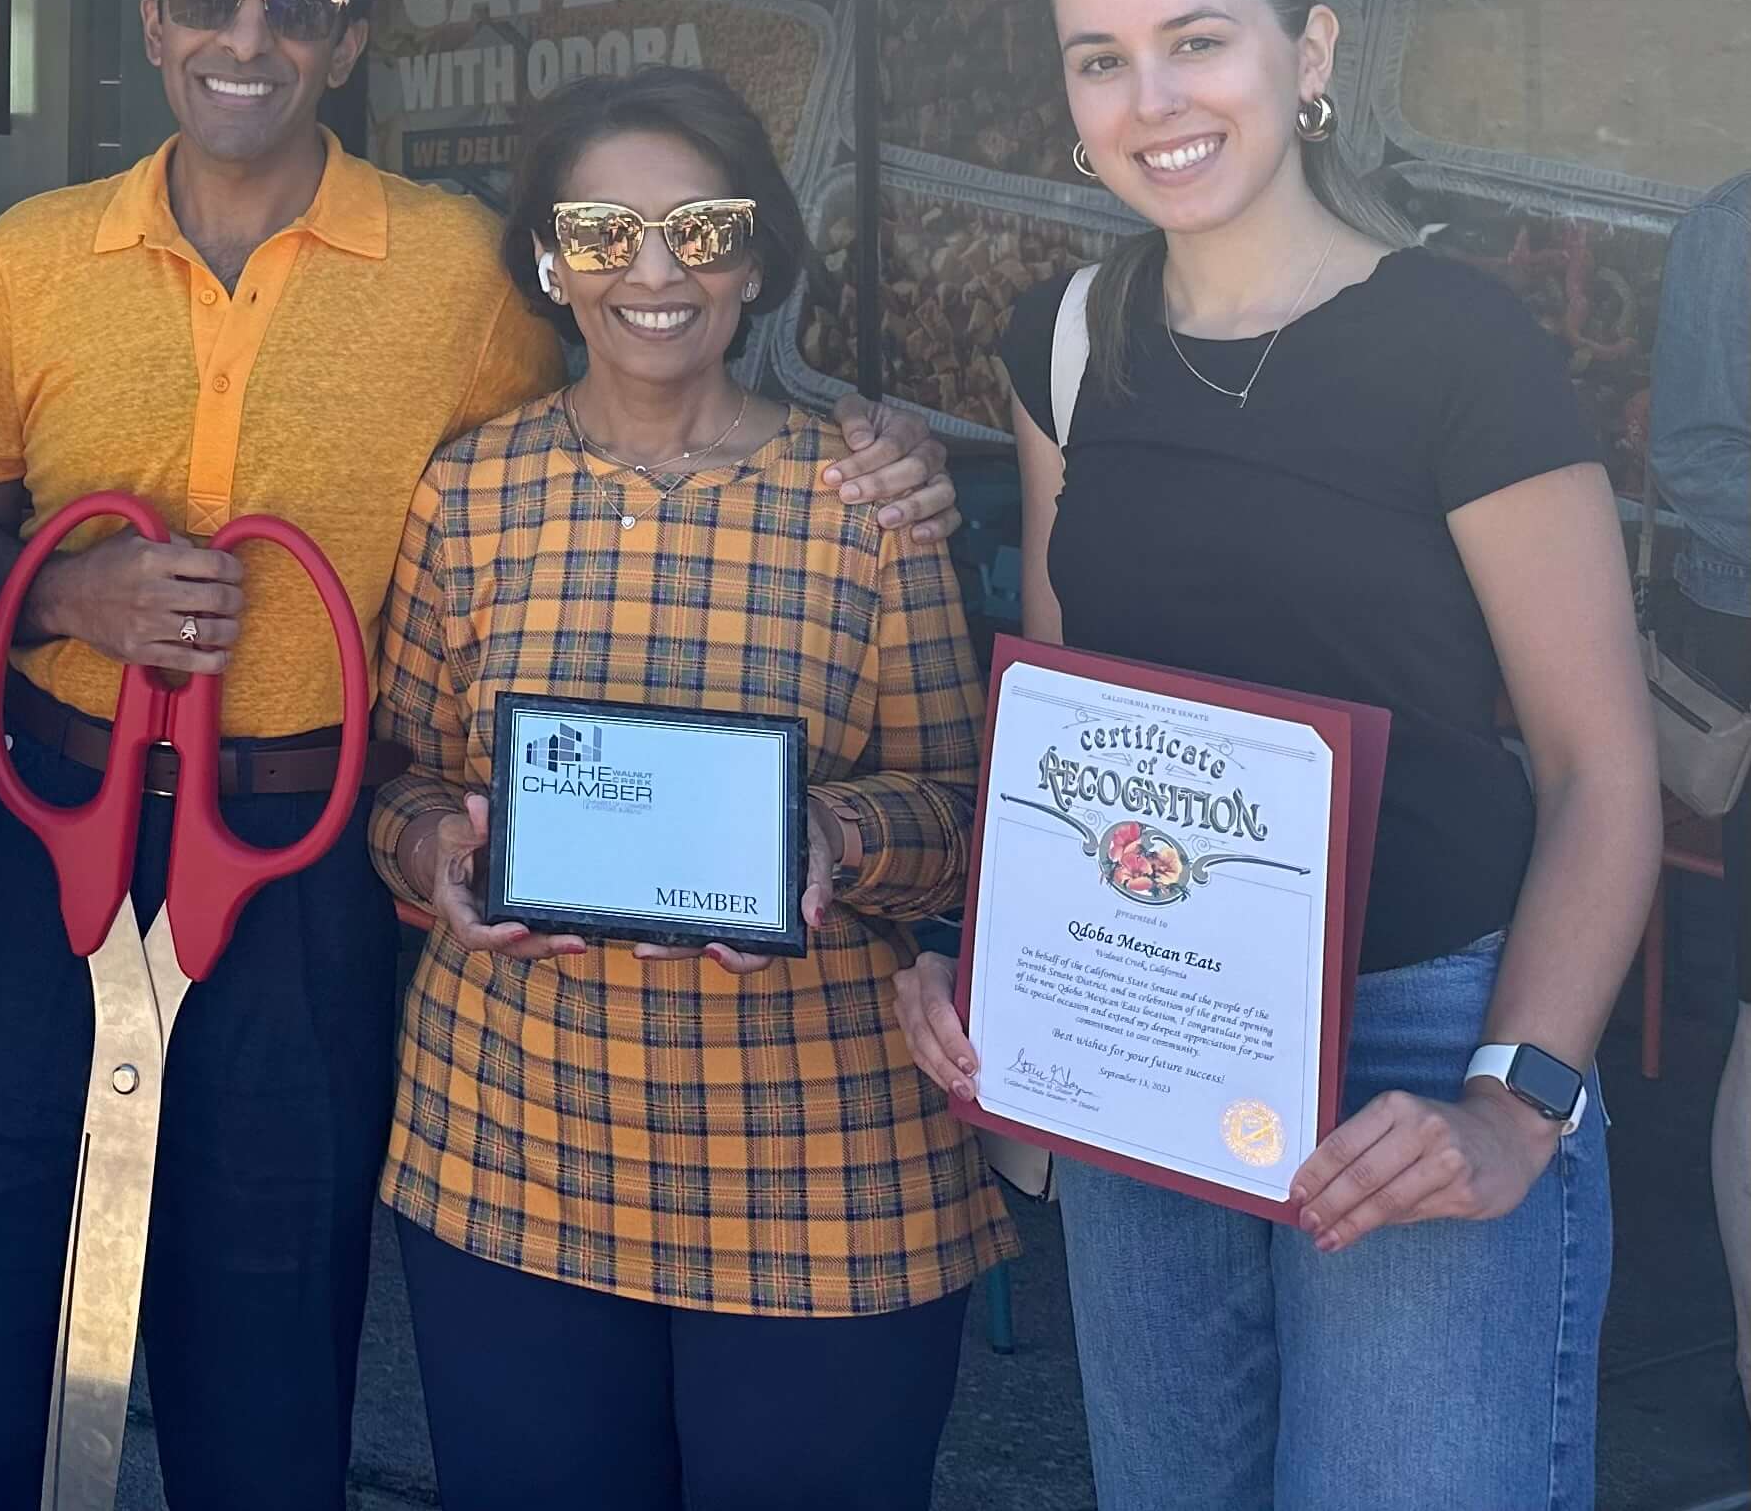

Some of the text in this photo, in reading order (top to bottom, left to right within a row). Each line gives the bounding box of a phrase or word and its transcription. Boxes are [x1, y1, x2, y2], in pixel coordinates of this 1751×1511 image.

[397, 44, 515, 111] WITH
[411, 135, 522, 168] WE DELI
[1101, 692, 1210, 722] CALIFORNIA STATE SENATE
[1080, 722, 1228, 780] certificate
[560, 762, 613, 783] THE
[612, 769, 653, 779] WALNUT
[1136, 756, 1159, 777] of
[522, 776, 653, 803] CHAMBER
[612, 778, 652, 786] CREEK
[1038, 745, 1269, 842] RECOGNITION
[655, 887, 758, 915] MEMBER
[1114, 908, 1169, 929] presented to
[1068, 920, 1223, 973] Qdoba Mexican Eats
[1021, 946, 1033, 957] On
[1035, 949, 1061, 966] behalf
[1060, 957, 1072, 969] of
[1084, 965, 1125, 983] California
[1125, 976, 1149, 989] State
[1213, 1000, 1241, 1014] people
[1243, 1006, 1256, 1018] of
[1255, 1008, 1270, 1020] the
[1185, 1005, 1197, 1017] of
[1197, 1007, 1211, 1019] the
[1211, 1013, 1238, 1026] grand
[1187, 1020, 1242, 1040] congratulate
[1051, 1027, 1074, 1043] Best
[1076, 1036, 1108, 1053] wishes
[1107, 1044, 1125, 1057] for
[1124, 1051, 1150, 1064] your
[1148, 1055, 1183, 1074] future
